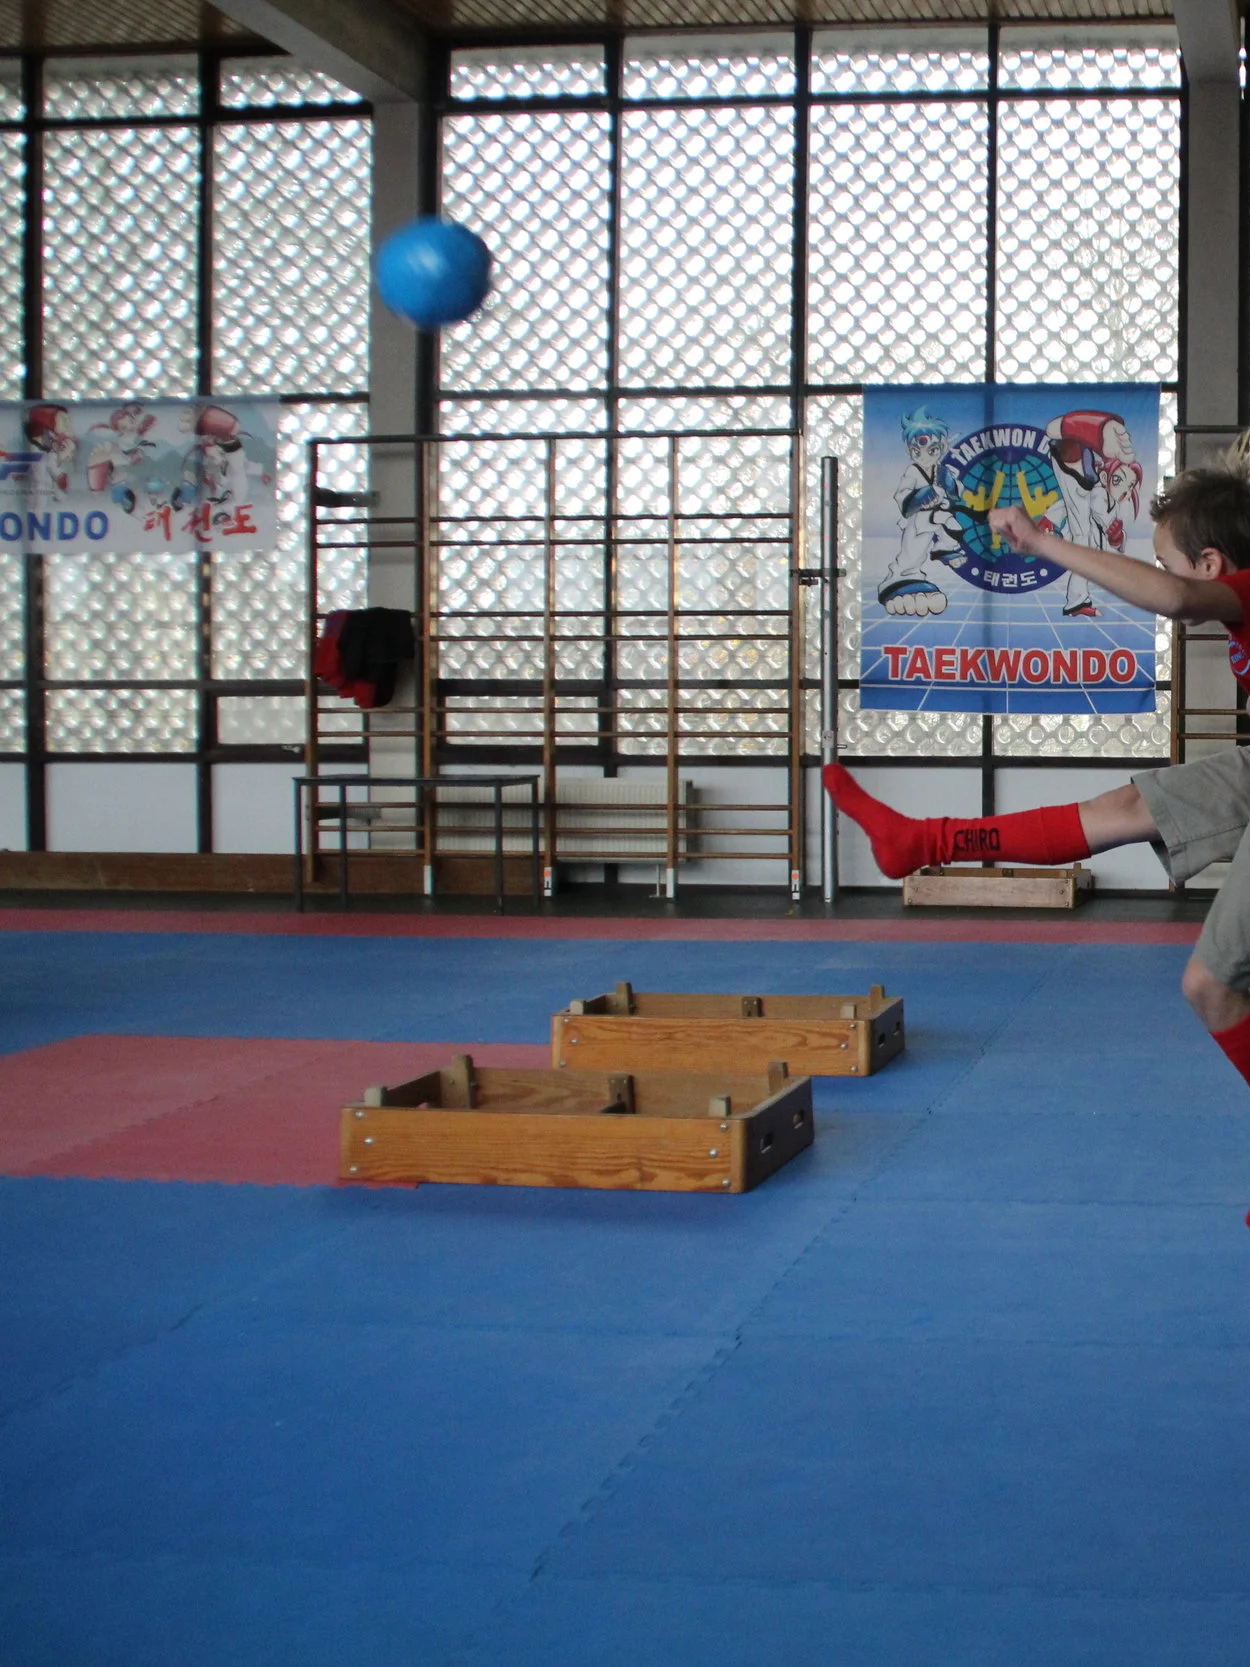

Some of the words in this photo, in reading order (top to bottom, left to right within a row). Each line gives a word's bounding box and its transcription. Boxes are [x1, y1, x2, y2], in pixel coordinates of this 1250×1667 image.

[950, 428, 1037, 466] TAEKWON
[1036, 434, 1053, 459] D
[983, 569, 1038, 588] 태권도
[882, 645, 1138, 684] TAEKWONDO
[953, 828, 1000, 851] CHIRO
